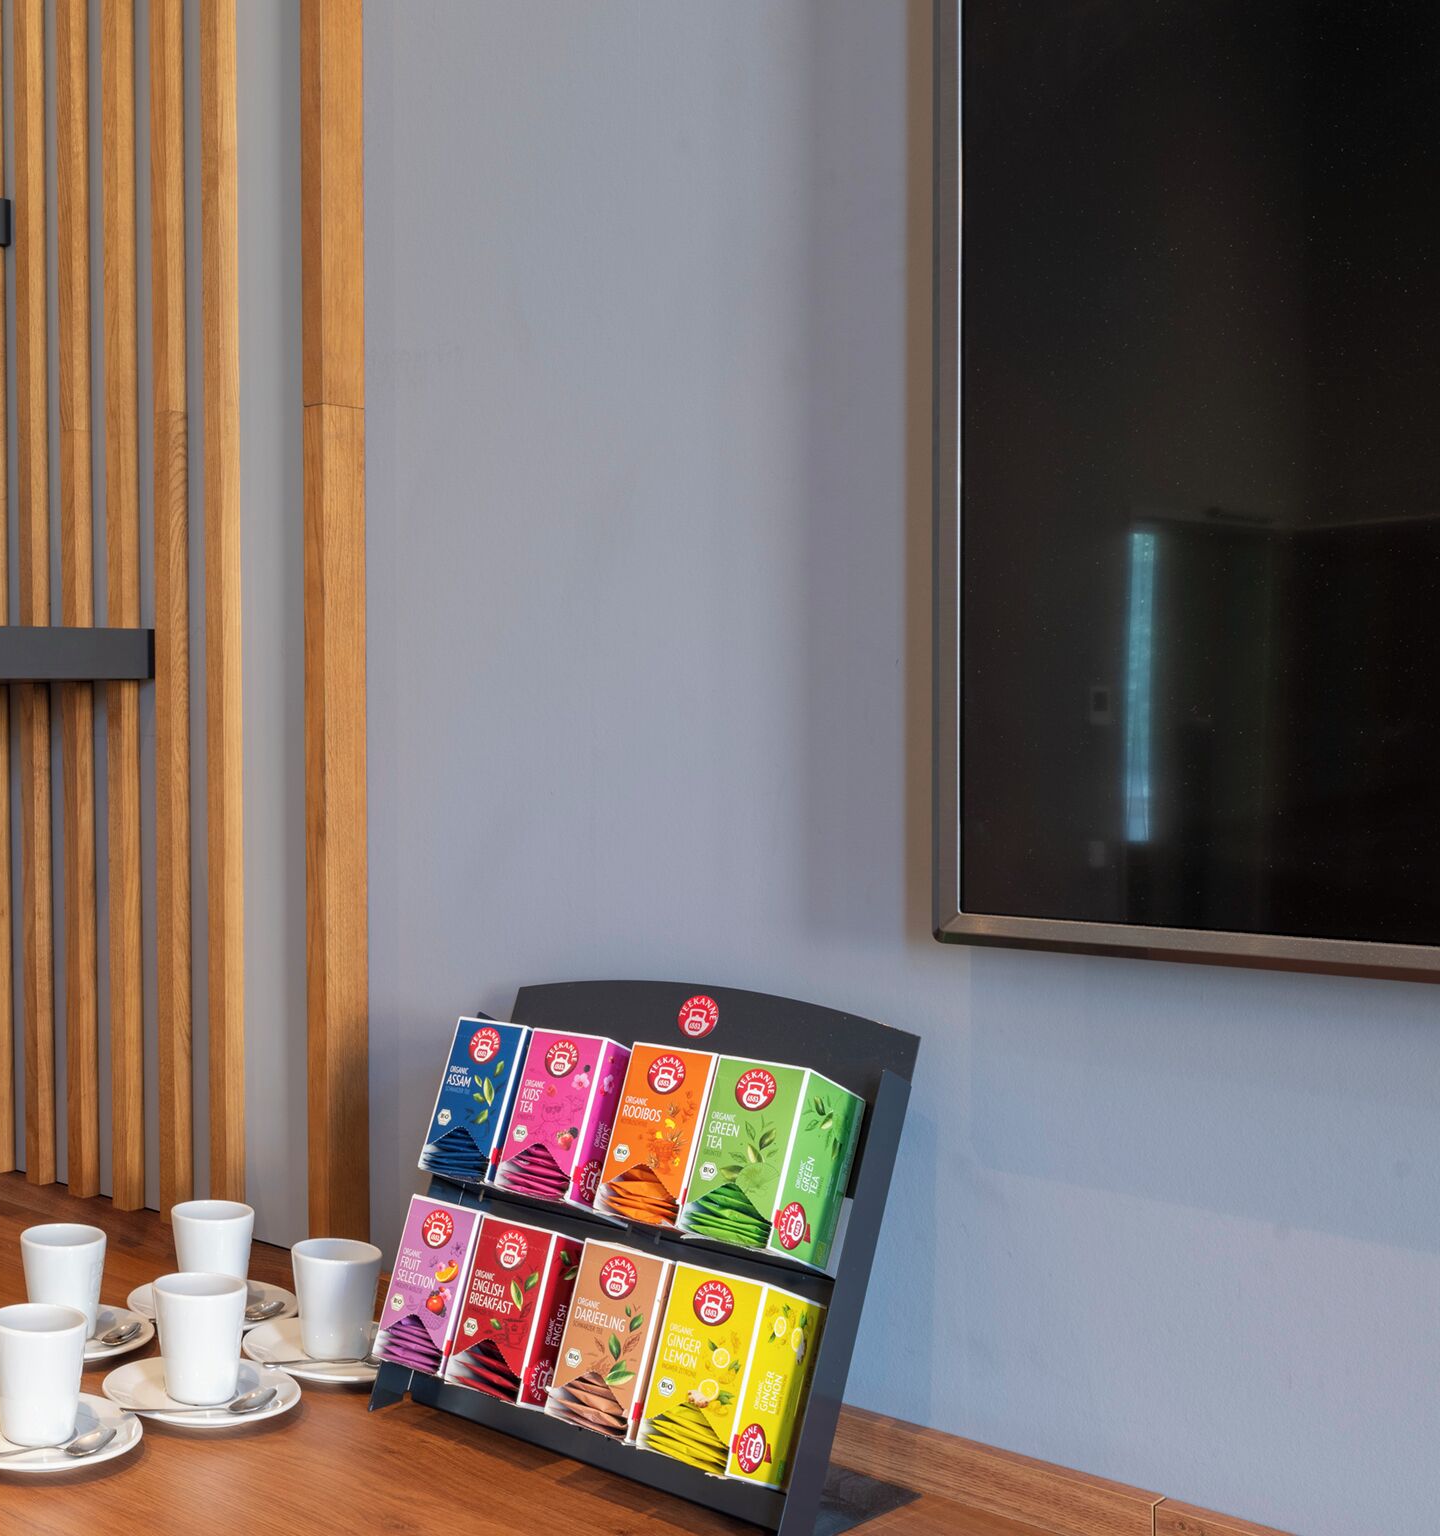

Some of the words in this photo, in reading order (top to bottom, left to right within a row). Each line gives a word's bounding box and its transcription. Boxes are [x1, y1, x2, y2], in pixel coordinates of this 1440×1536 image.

[679, 997, 718, 1021] TEEKANNE
[471, 1029, 500, 1049] TEEKANNE
[547, 1041, 578, 1062] TEEKANNE
[450, 1065, 469, 1075] ORGANIC
[649, 1056, 684, 1079] TEEKANNE
[446, 1074, 472, 1087] ASSAM
[525, 1079, 545, 1089] ORGANIC
[737, 1071, 775, 1094] TEEKANNE
[520, 1101, 533, 1113] TEA
[625, 1096, 648, 1106] ORGANIC
[622, 1105, 662, 1122] ROOIBOS
[712, 1111, 736, 1123] ORGANIC
[594, 1121, 604, 1148] ORGANIC
[709, 1120, 740, 1137] GREEN
[706, 1135, 722, 1150] TEA
[795, 1159, 807, 1189] ORGANIC
[801, 1156, 816, 1192] GREEN
[808, 1176, 820, 1194] TEA
[424, 1211, 454, 1234] TEEKANNE
[780, 1204, 799, 1248] TEEKANNE
[403, 1247, 422, 1258] ORGANIC
[496, 1232, 528, 1255] TEEKANNE
[400, 1256, 422, 1272] FRUIT
[602, 1258, 636, 1283] TEEKANNE
[397, 1269, 436, 1290] SELECTION
[475, 1269, 495, 1281] ORGANIC
[472, 1278, 505, 1297] ENGLISH
[695, 1283, 733, 1309] TEEKANNE
[469, 1291, 514, 1314] BREAKFAST
[577, 1297, 600, 1310] ORGANIC
[551, 1304, 567, 1347] ENGLISH
[574, 1306, 626, 1333] DARJEELING
[670, 1323, 694, 1336] ORGANIC
[545, 1318, 556, 1345] ORGANIC
[667, 1333, 702, 1354] GINGER
[663, 1348, 698, 1369] LEMON
[530, 1359, 550, 1401] TEEKANNE
[754, 1381, 765, 1410] ORGANIC
[759, 1371, 775, 1412] GINGER
[767, 1375, 783, 1415] LEMON
[738, 1425, 758, 1472] TEEKANNE
